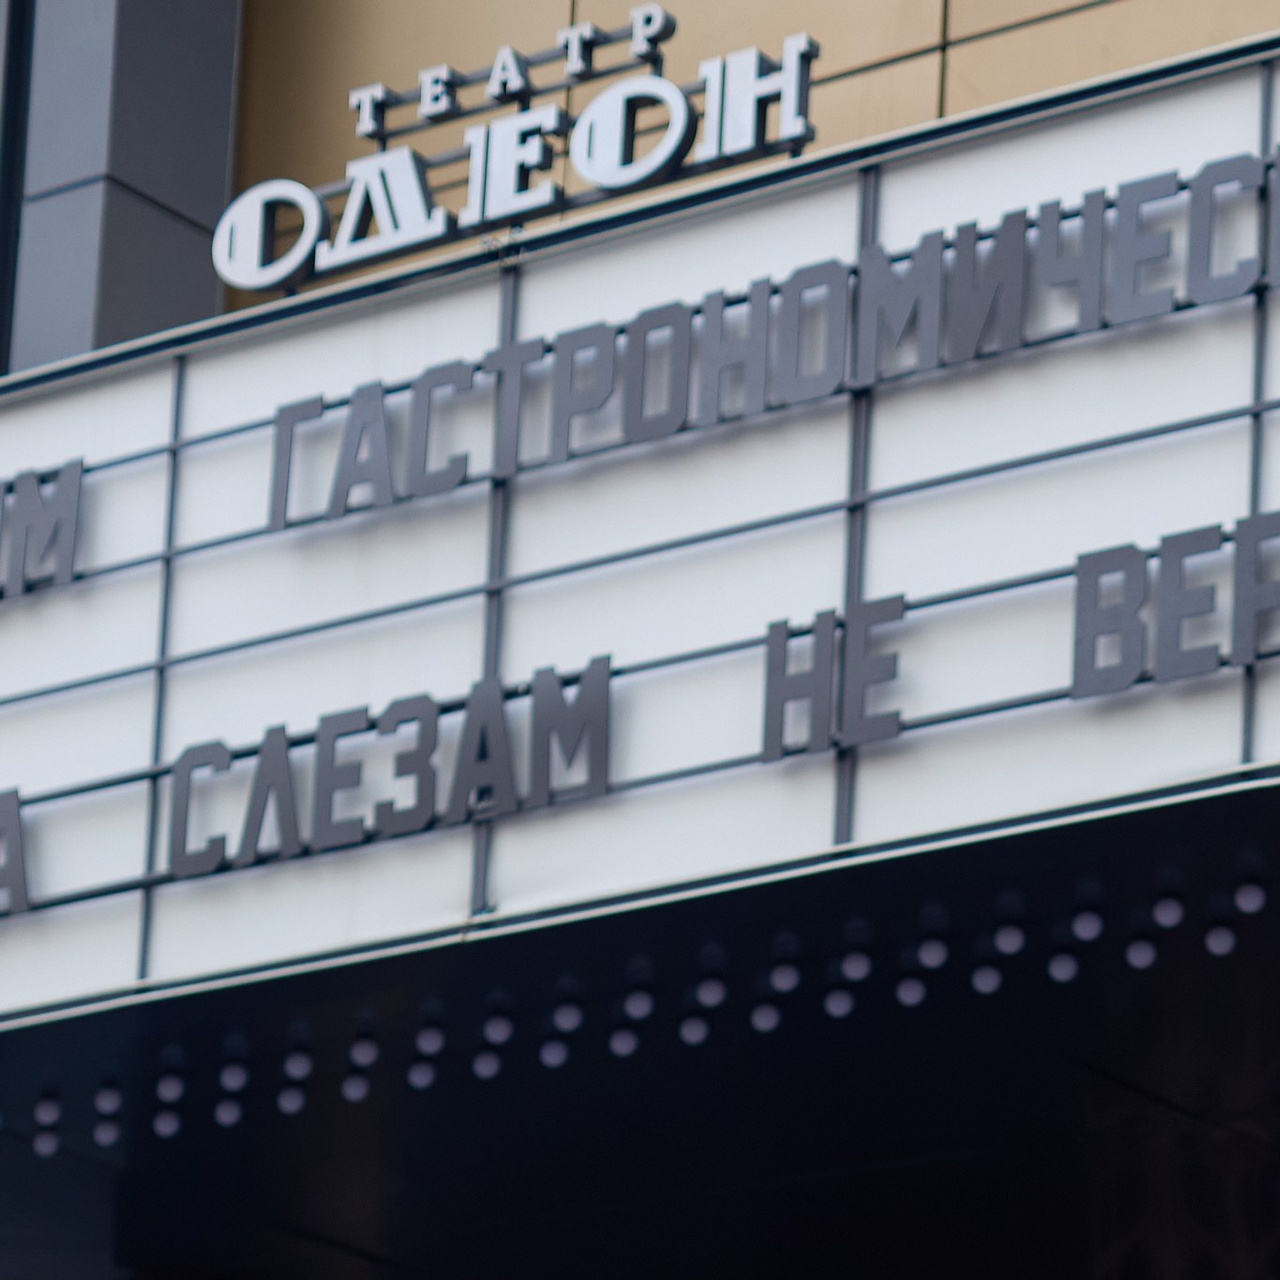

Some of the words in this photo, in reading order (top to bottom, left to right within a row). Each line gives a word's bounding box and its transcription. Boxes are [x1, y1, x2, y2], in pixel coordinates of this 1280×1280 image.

[211, 32, 820, 290] ОДЕОН
[349, 3, 676, 138] ТЕАТР
[167, 654, 611, 877] СЛЕЗАМ
[762, 594, 905, 763] НЕ
